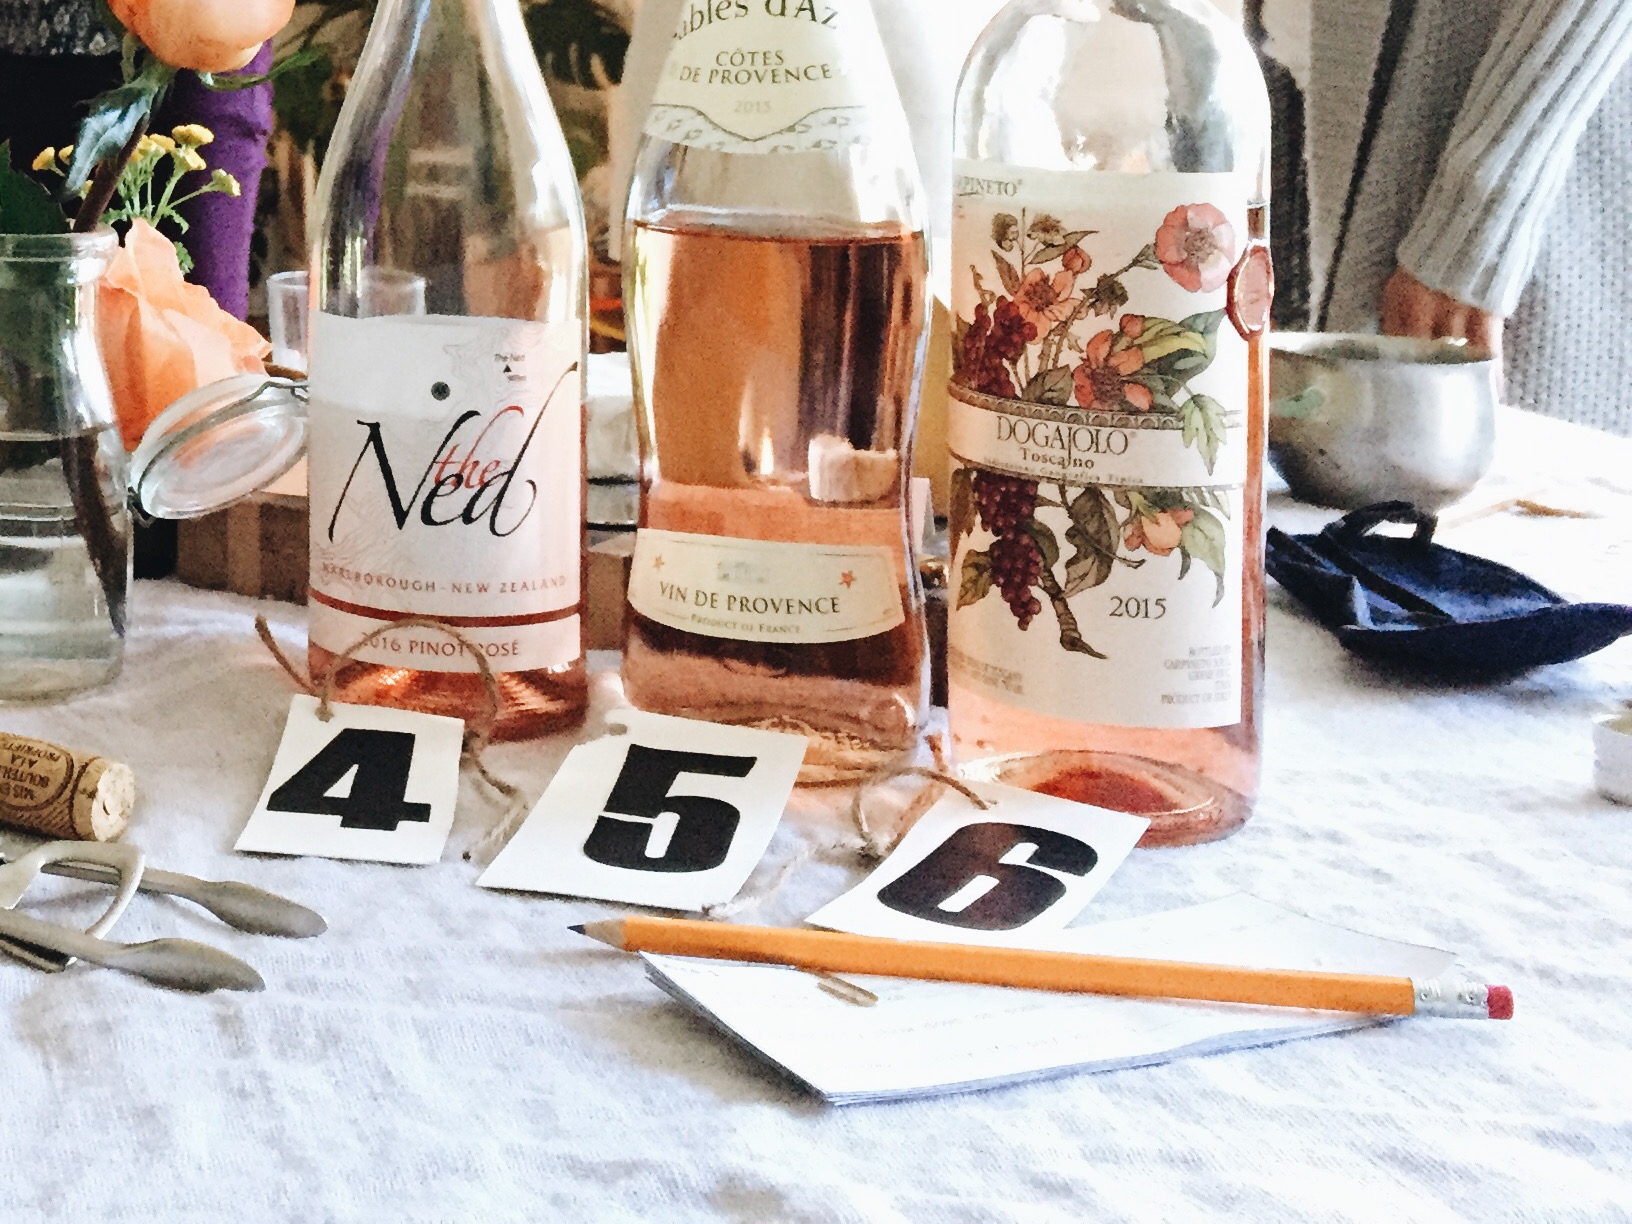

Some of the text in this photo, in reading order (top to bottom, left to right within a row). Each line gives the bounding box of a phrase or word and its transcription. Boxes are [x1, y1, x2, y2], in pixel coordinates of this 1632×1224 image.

[679, 63, 833, 85] DE PROVENCE
[715, 47, 785, 67] CÔTES
[328, 360, 578, 543] the Ned
[996, 415, 1129, 464] DOGAJOLO
[1019, 446, 1095, 470] Toscano
[321, 561, 437, 593] MARLBOROUGH
[451, 582, 490, 594] NEW
[499, 574, 567, 594] ZEALAND
[659, 581, 841, 616] VIN DE PROVENCE
[1108, 595, 1167, 620] 2015
[408, 639, 465, 657] PINOT
[265, 728, 431, 832] 4
[582, 743, 760, 874] 5
[876, 821, 1099, 931] 6
